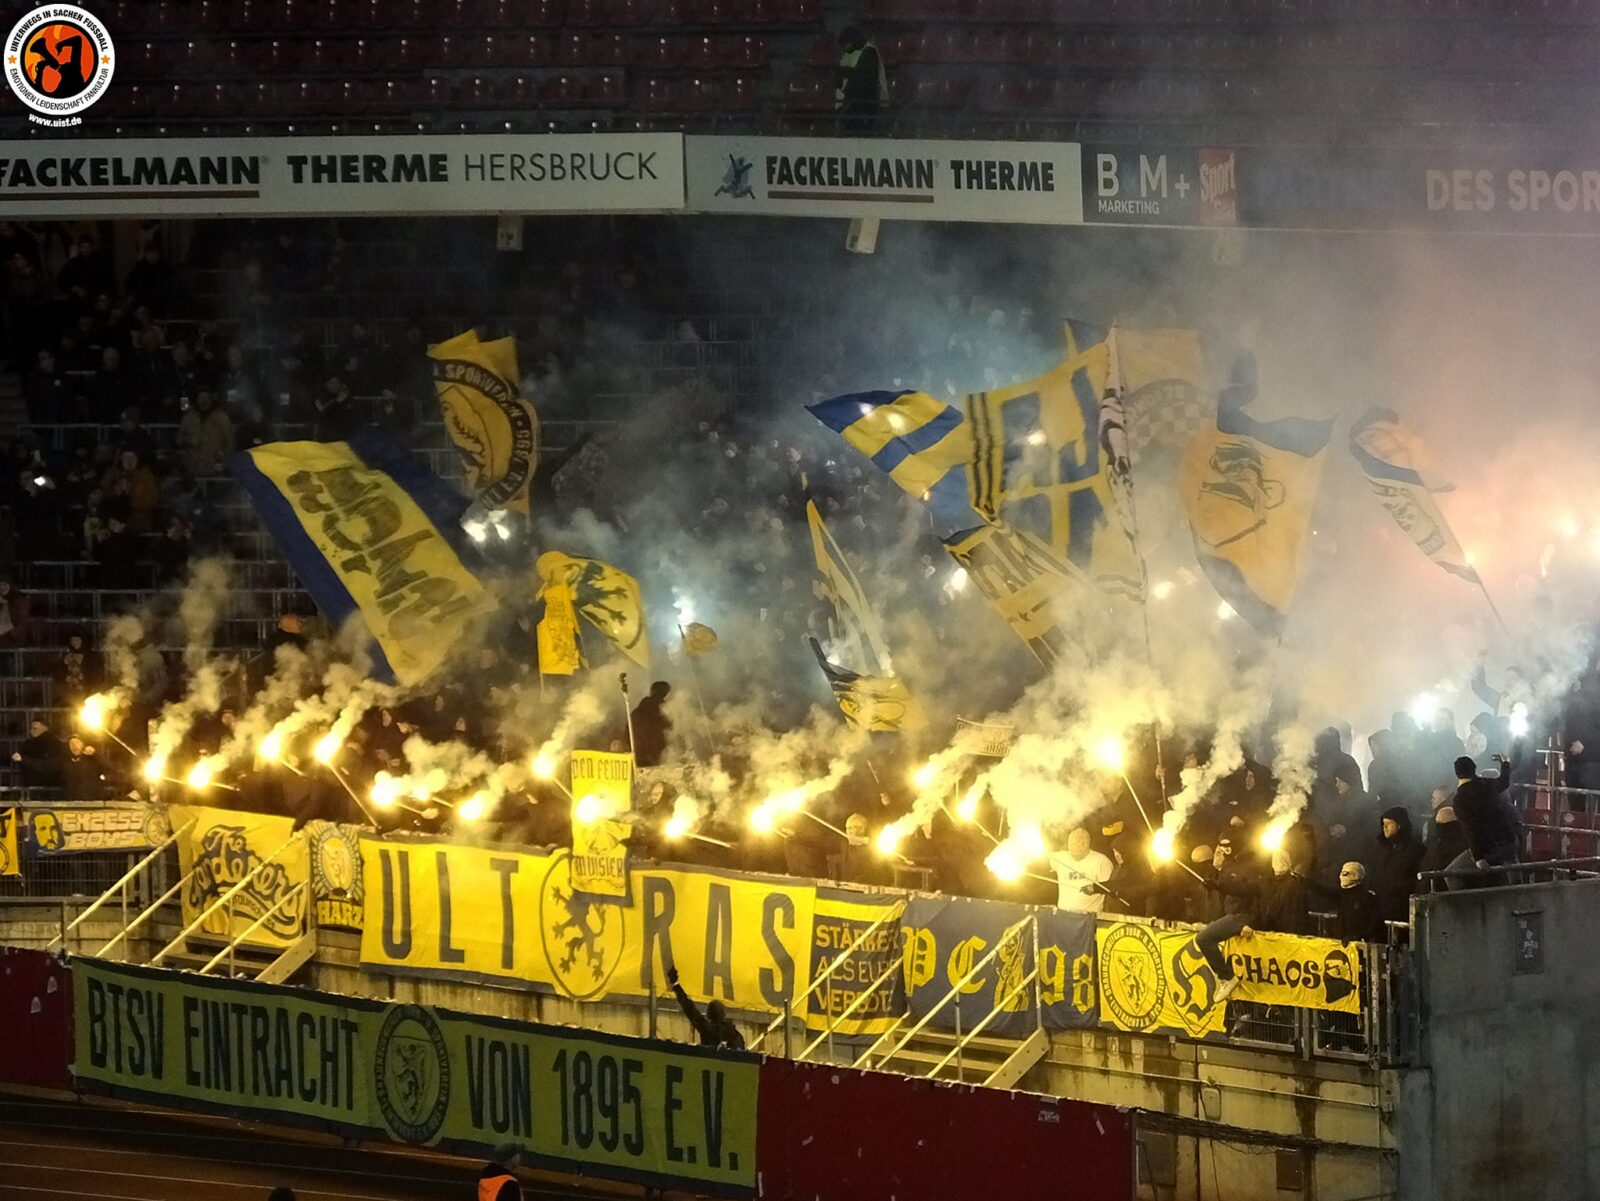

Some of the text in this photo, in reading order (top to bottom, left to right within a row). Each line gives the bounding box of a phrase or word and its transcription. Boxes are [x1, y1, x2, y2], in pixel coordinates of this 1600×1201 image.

[287, 154, 449, 185] THERME
[464, 151, 658, 182] HERSBRUCK
[765, 155, 1055, 192] FACKELMANN THERME
[1098, 199, 1161, 216] MARKETING
[1426, 169, 1496, 211] DES
[815, 956, 855, 982] ALS
[1226, 953, 1321, 990] CHAOS
[87, 977, 166, 1081] BTSV
[183, 996, 358, 1111] EINTRACHT
[465, 1034, 532, 1139] VON
[551, 1048, 647, 1158] 1895
[665, 1064, 740, 1171] E.V.
